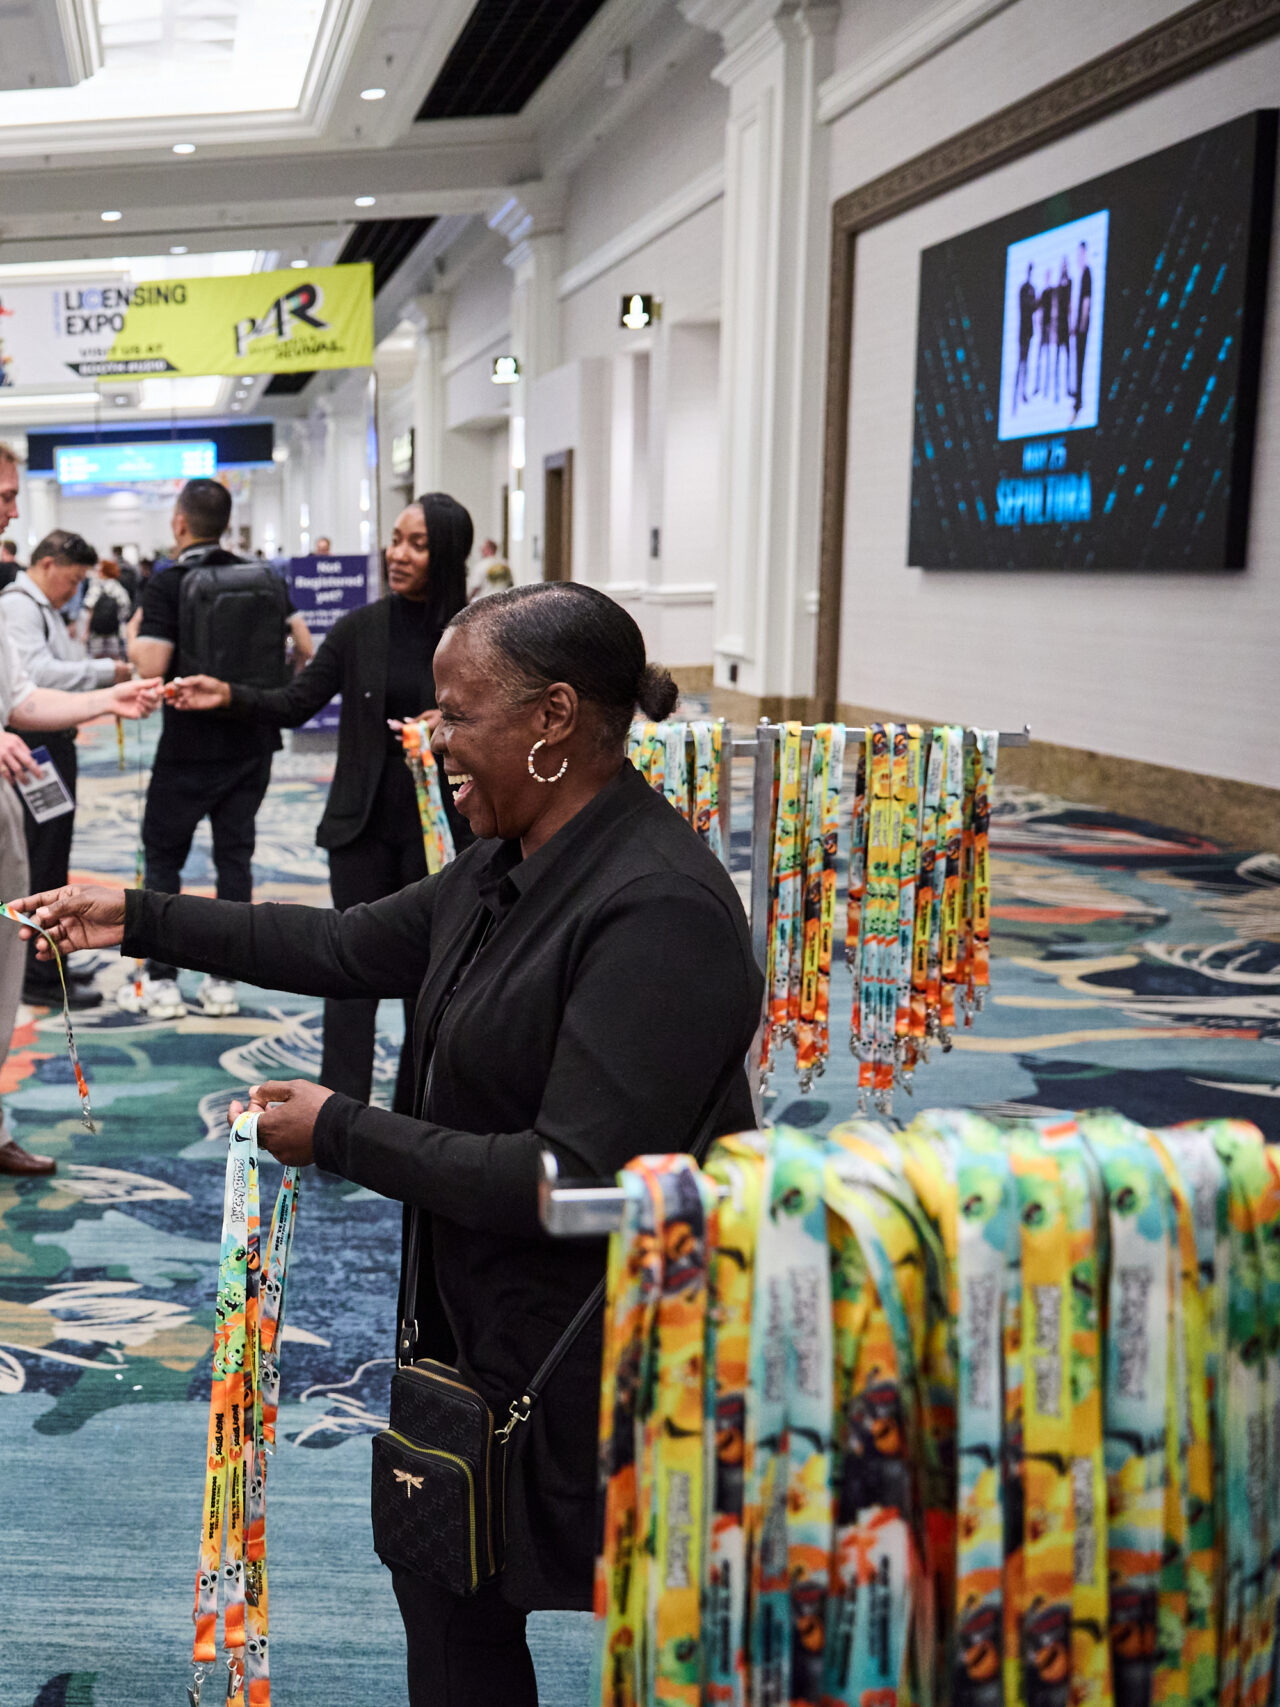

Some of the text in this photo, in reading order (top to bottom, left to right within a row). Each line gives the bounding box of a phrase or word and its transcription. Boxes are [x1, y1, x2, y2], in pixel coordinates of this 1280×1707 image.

[65, 284, 187, 311] LICENSING
[66, 313, 124, 335] EXPO
[231, 1158, 246, 1223] ANGRY BIRDS
[209, 1455, 226, 1471] 3
